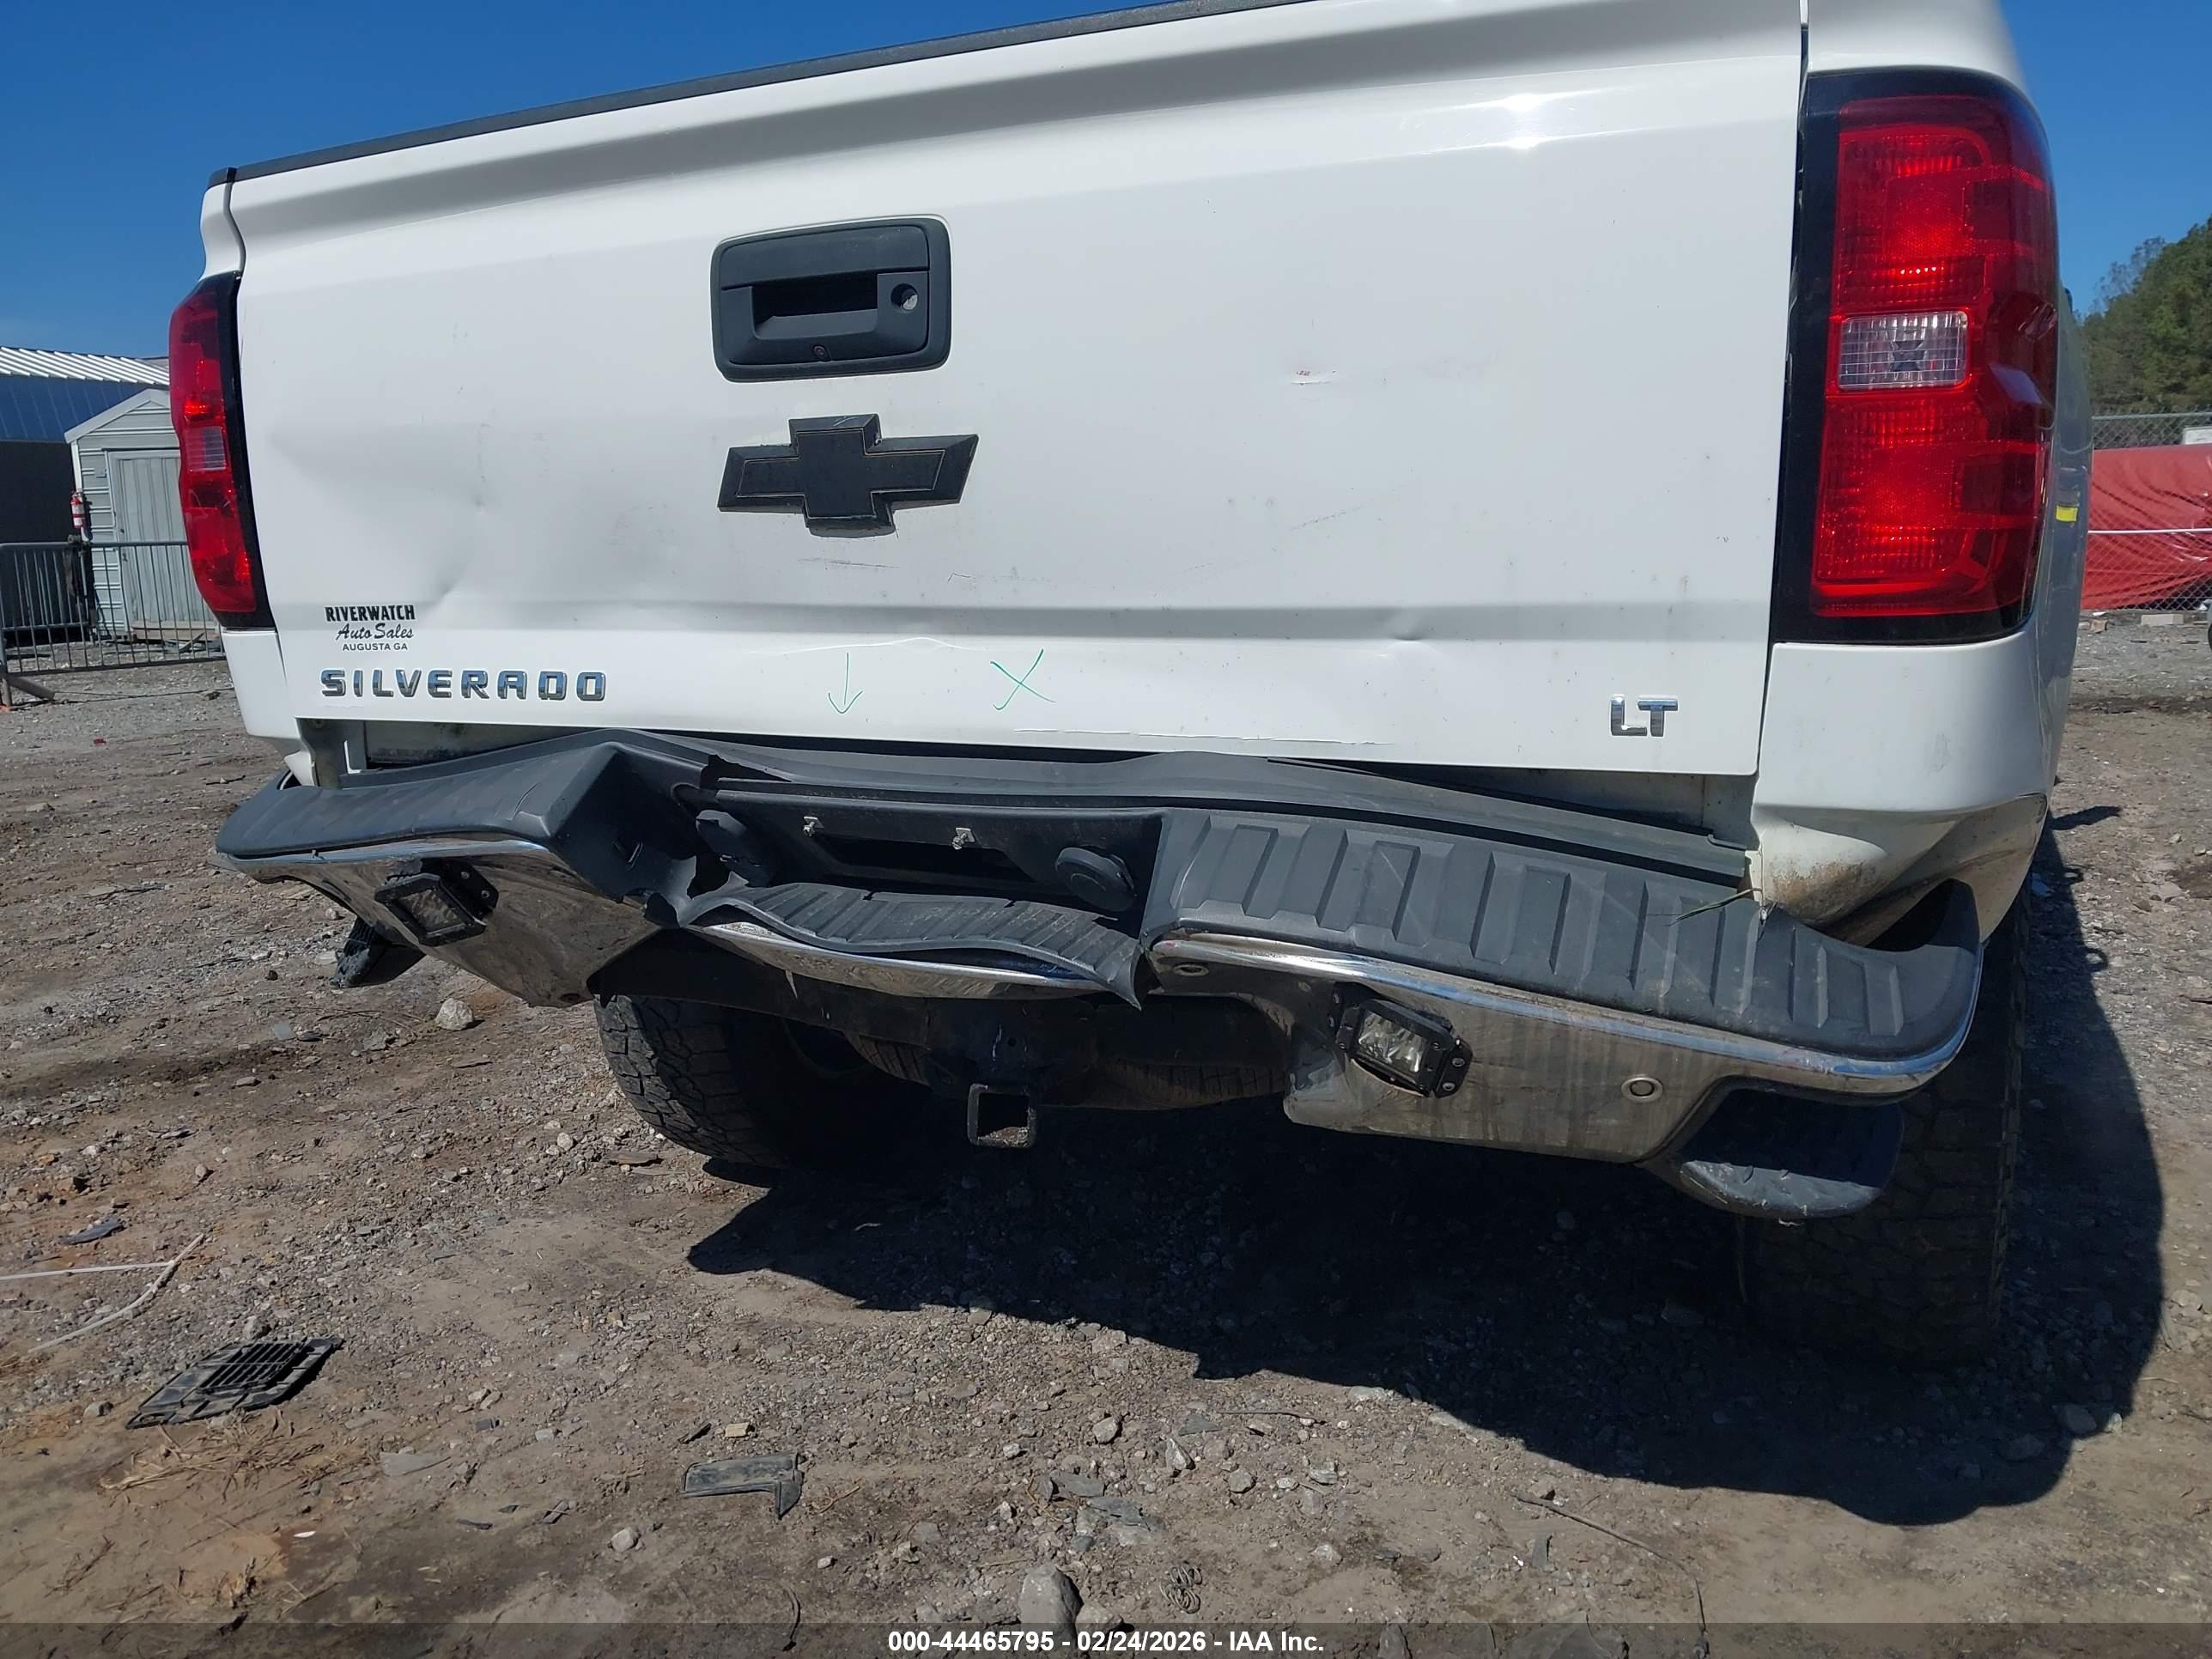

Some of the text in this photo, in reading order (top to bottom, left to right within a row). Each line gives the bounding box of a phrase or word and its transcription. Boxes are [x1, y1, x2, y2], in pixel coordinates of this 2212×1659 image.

[325, 605, 416, 622] RIVERWATCH
[336, 623, 414, 641] Auto Sales
[393, 642, 408, 651] GA
[319, 669, 607, 702] SILVERADO
[1610, 694, 1679, 738] LT
